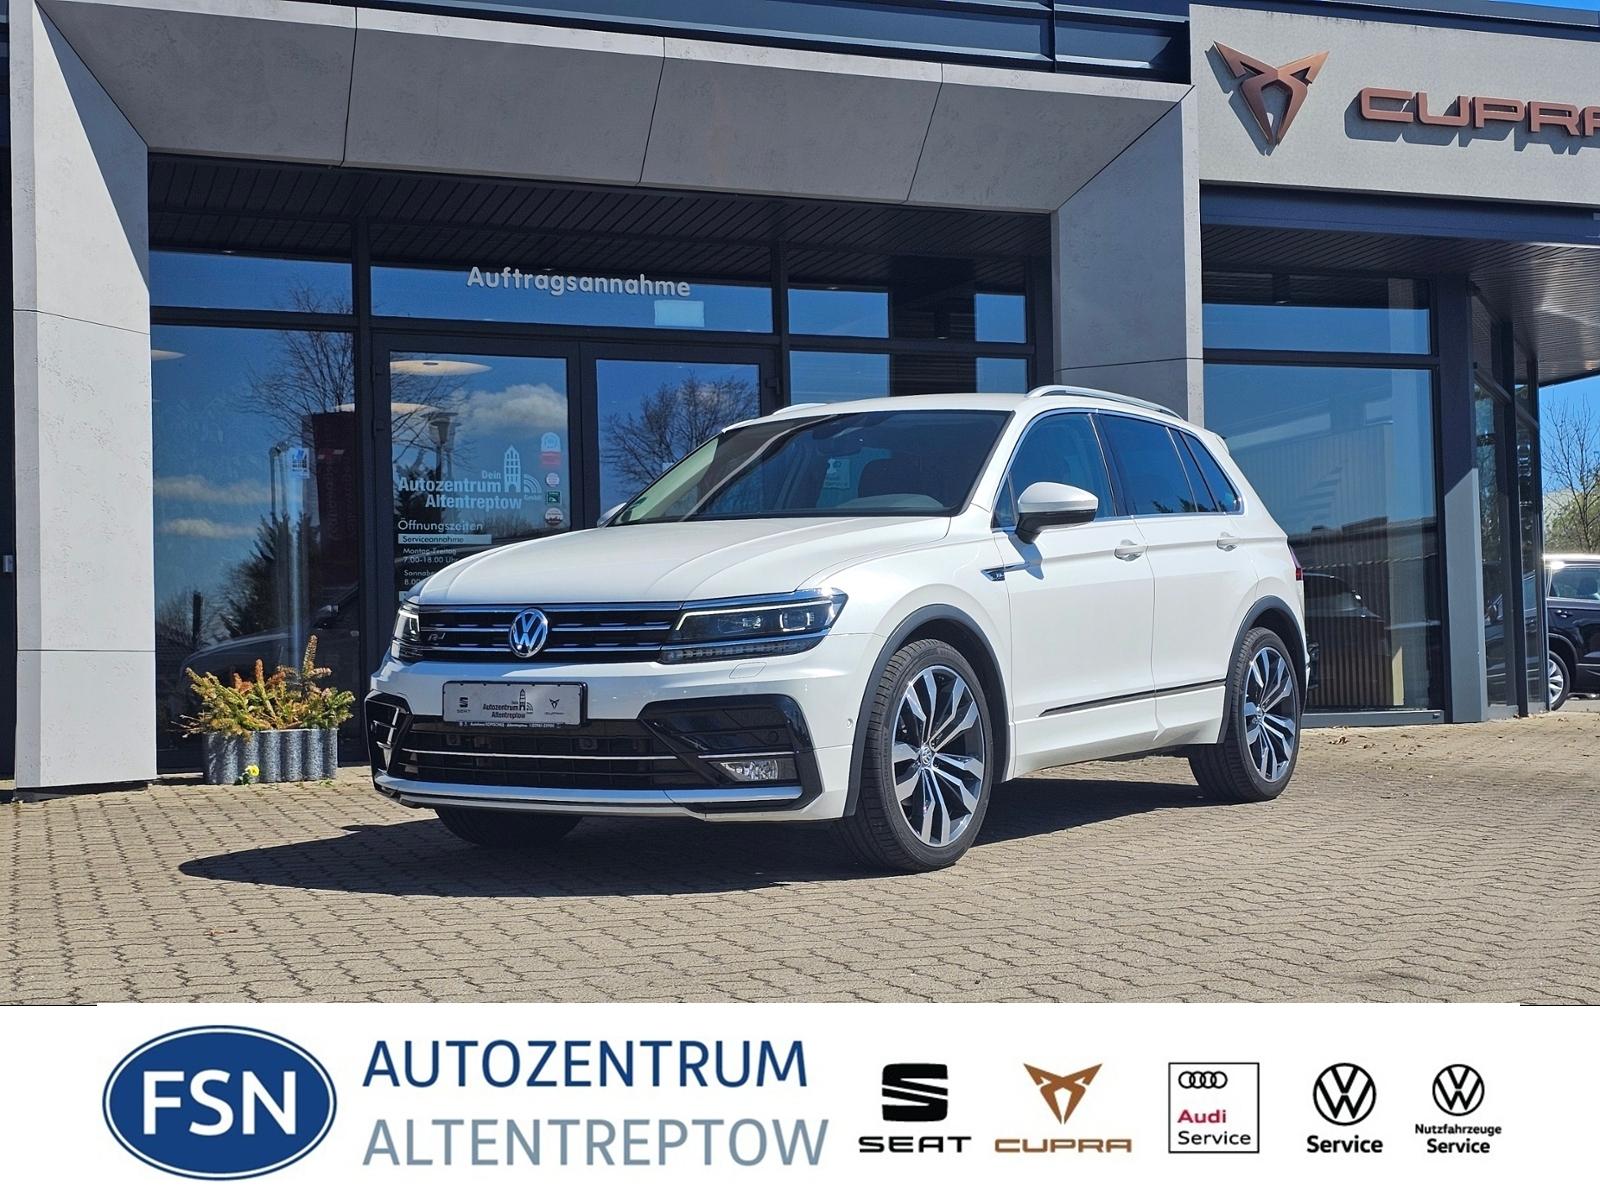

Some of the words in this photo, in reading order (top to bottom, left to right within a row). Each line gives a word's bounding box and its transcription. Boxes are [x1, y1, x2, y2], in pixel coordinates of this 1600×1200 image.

[467, 266, 691, 297] Auftragsannahme
[481, 470, 501, 480] Dein
[398, 477, 501, 492] Autozentrum
[425, 494, 522, 512] Altentreptow
[397, 517, 484, 533] Öffnungszeiten
[402, 535, 465, 544] Serviceannahme
[482, 703, 519, 711] Autozentrum
[491, 711, 526, 720] Altentreptow
